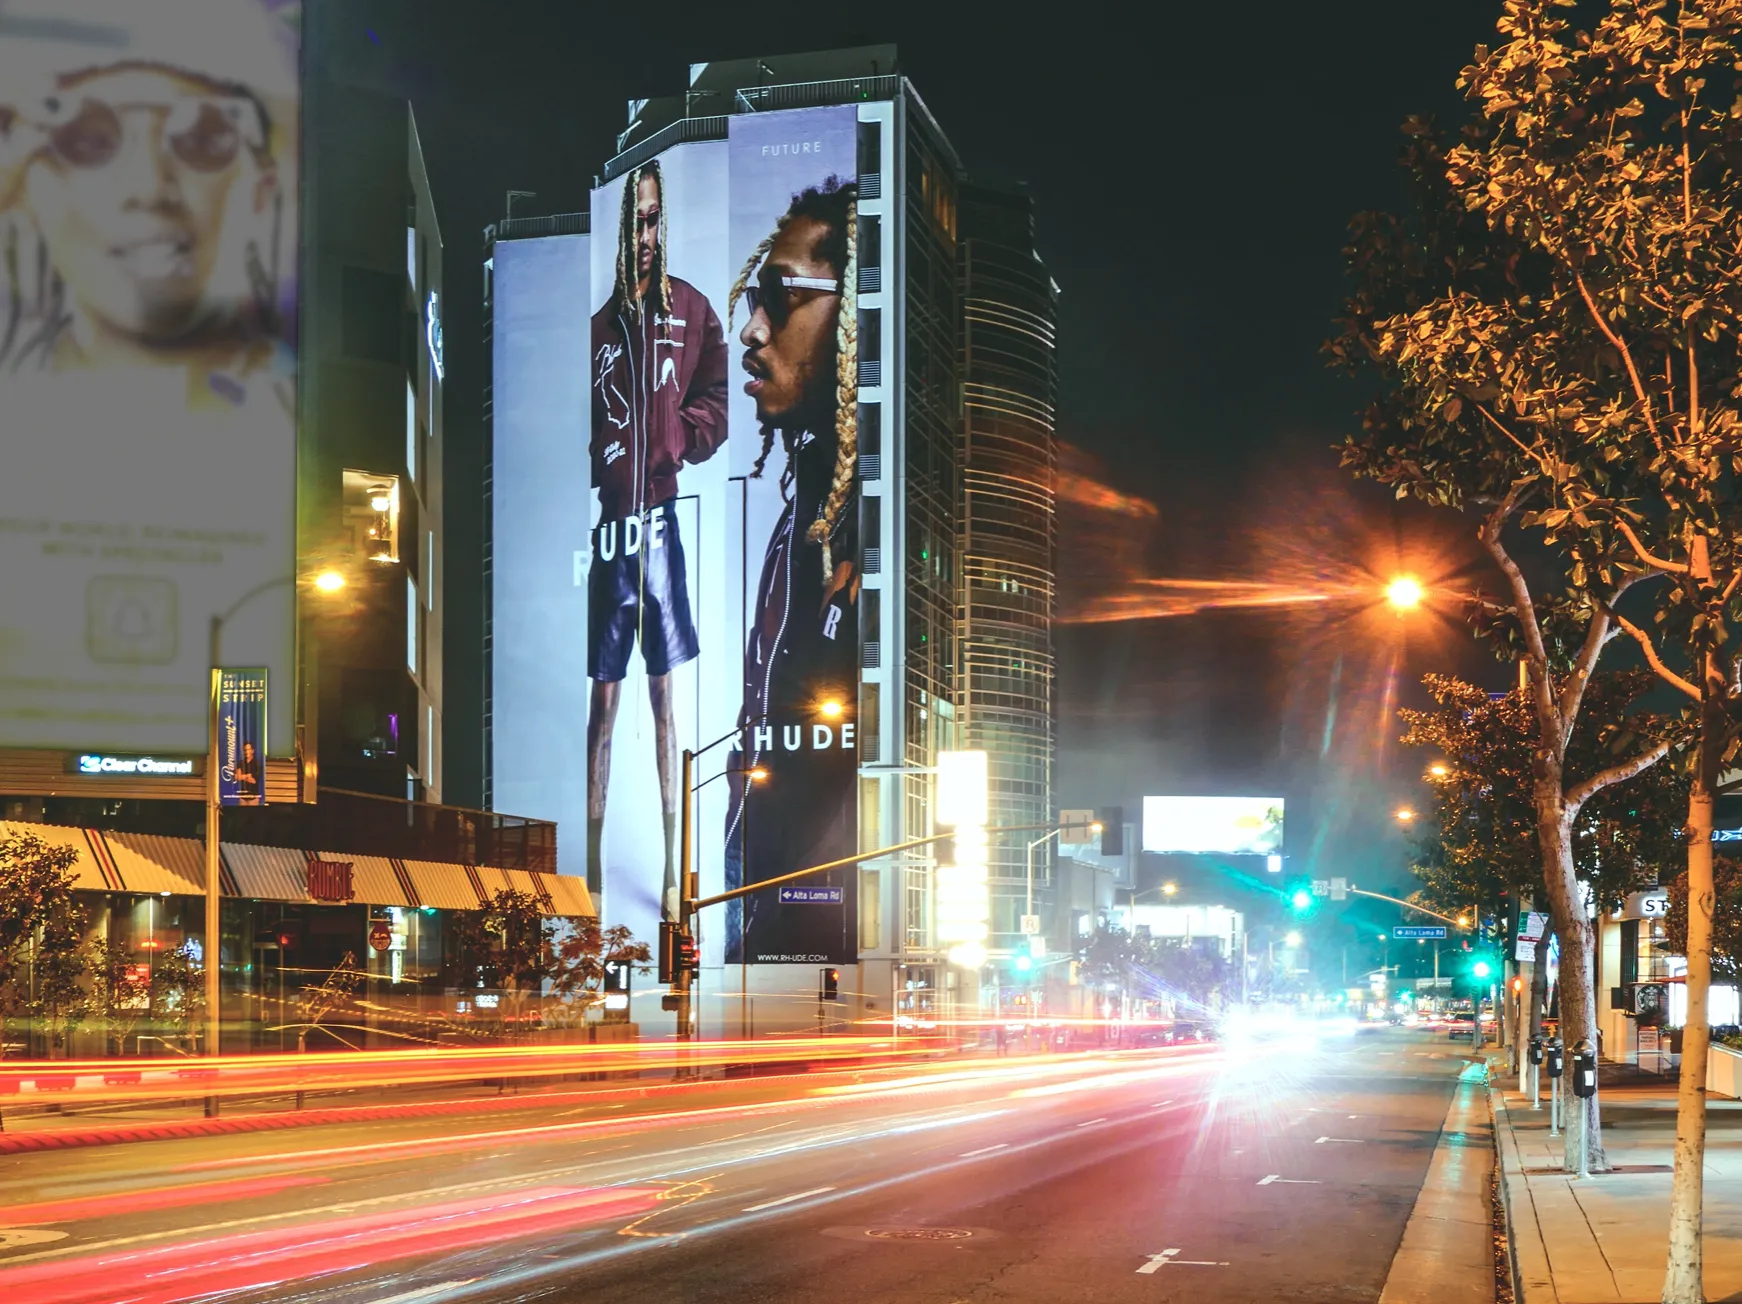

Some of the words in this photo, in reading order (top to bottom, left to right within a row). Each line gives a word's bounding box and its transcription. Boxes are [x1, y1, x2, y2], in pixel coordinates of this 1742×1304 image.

[762, 141, 821, 157] FUTURE
[223, 680, 264, 688] SUNSET
[223, 693, 264, 703] STRIP
[729, 723, 855, 751] RHUDE
[101, 757, 137, 772] Clear
[137, 757, 192, 773] Channel
[308, 860, 355, 900] RUMBLE
[792, 891, 808, 900] Alta
[809, 891, 828, 900] Loma
[829, 891, 840, 900] Rd
[757, 954, 828, 962] WWW.RH-UDE.COM
